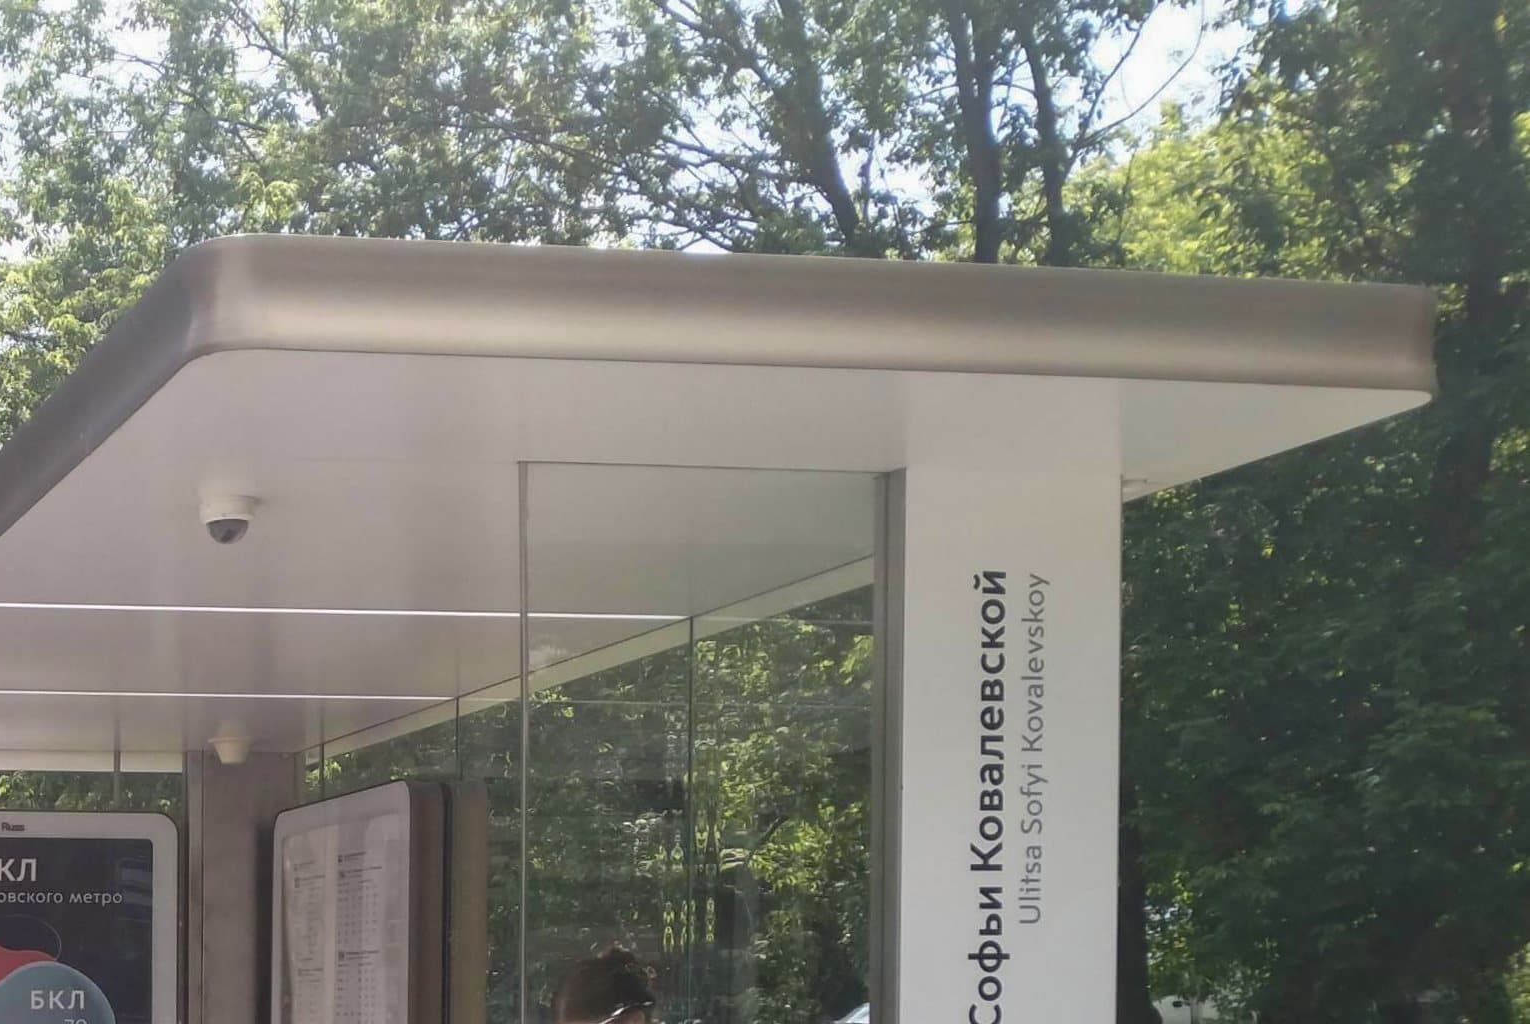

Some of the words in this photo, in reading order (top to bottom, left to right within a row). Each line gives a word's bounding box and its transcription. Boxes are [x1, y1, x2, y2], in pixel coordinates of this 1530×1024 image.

[1020, 571, 1051, 753] Kovalevskoy
[969, 570, 1007, 872] Ковалевской
[1, 821, 26, 833] Russ
[1019, 762, 1049, 835] Sofyi
[69, 891, 123, 906] метро
[1017, 845, 1042, 925] Ulitsa
[30, 990, 86, 1011] БКЛ
